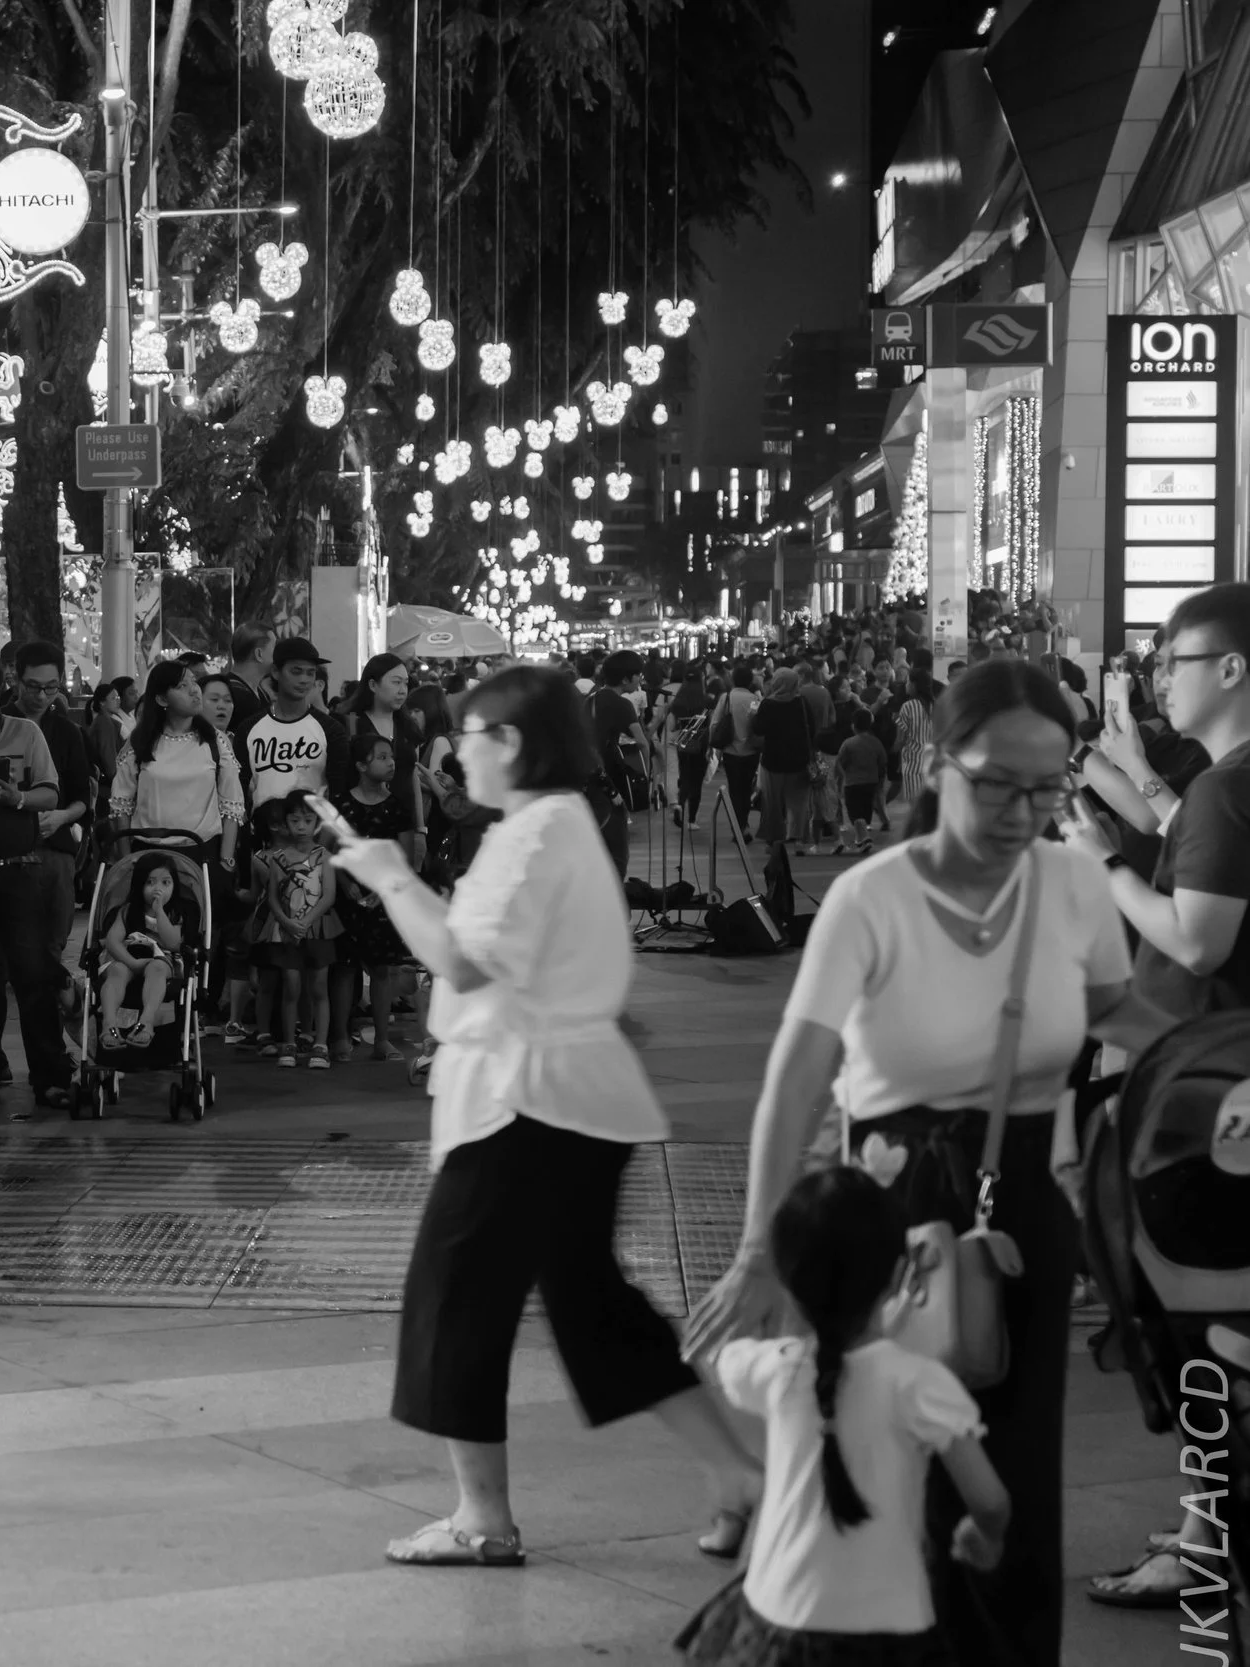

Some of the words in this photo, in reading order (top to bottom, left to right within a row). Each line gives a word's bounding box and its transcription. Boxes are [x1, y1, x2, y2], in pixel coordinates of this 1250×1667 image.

[881, 346, 916, 360] MRT
[1130, 361, 1215, 373] ORCHARD
[85, 432, 122, 445] Please
[128, 432, 149, 444] Use
[88, 448, 147, 463] Underpass
[253, 736, 322, 773] Mate
